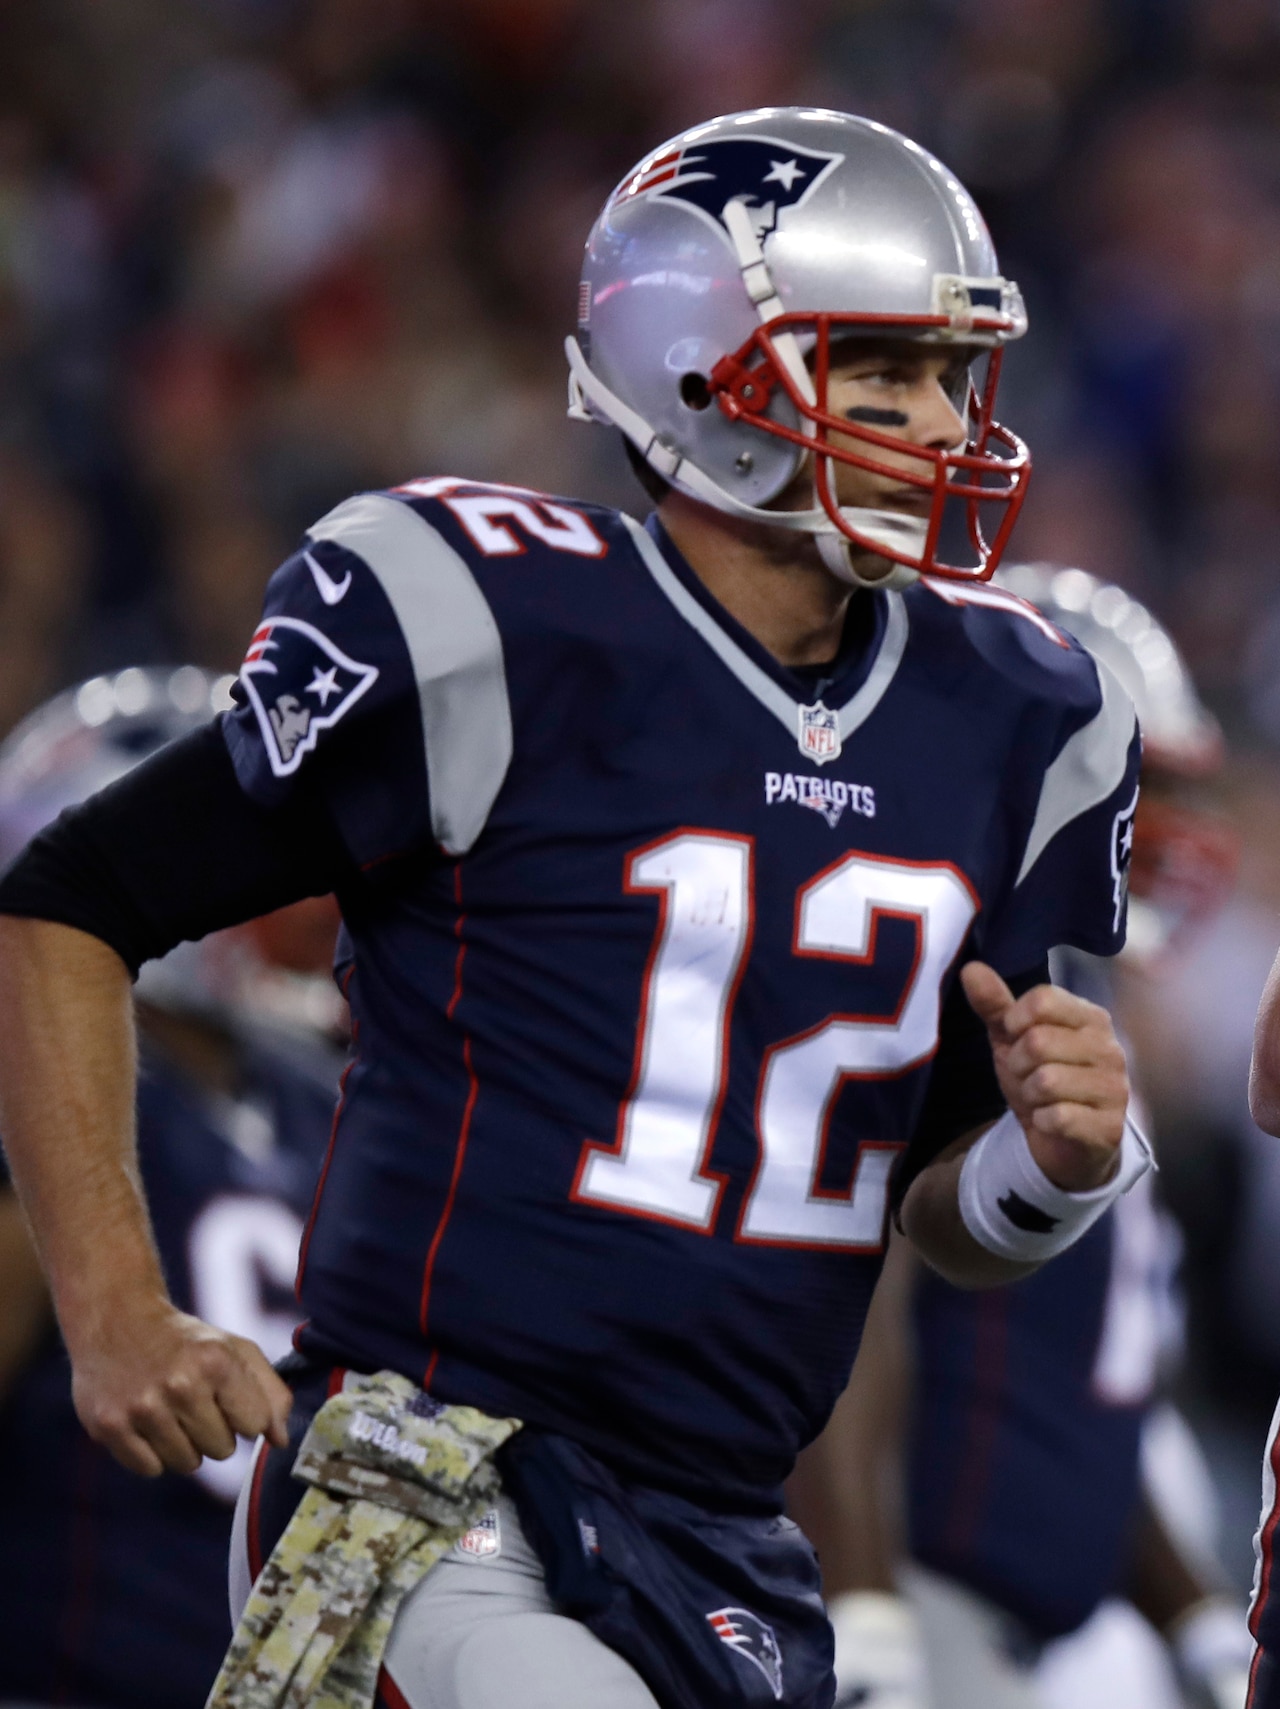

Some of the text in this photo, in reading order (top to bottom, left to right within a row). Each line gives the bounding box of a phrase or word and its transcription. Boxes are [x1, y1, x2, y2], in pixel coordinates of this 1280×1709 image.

[806, 726, 835, 753] NFL
[764, 771, 877, 819] PATRIOTS
[569, 826, 982, 1255] 12
